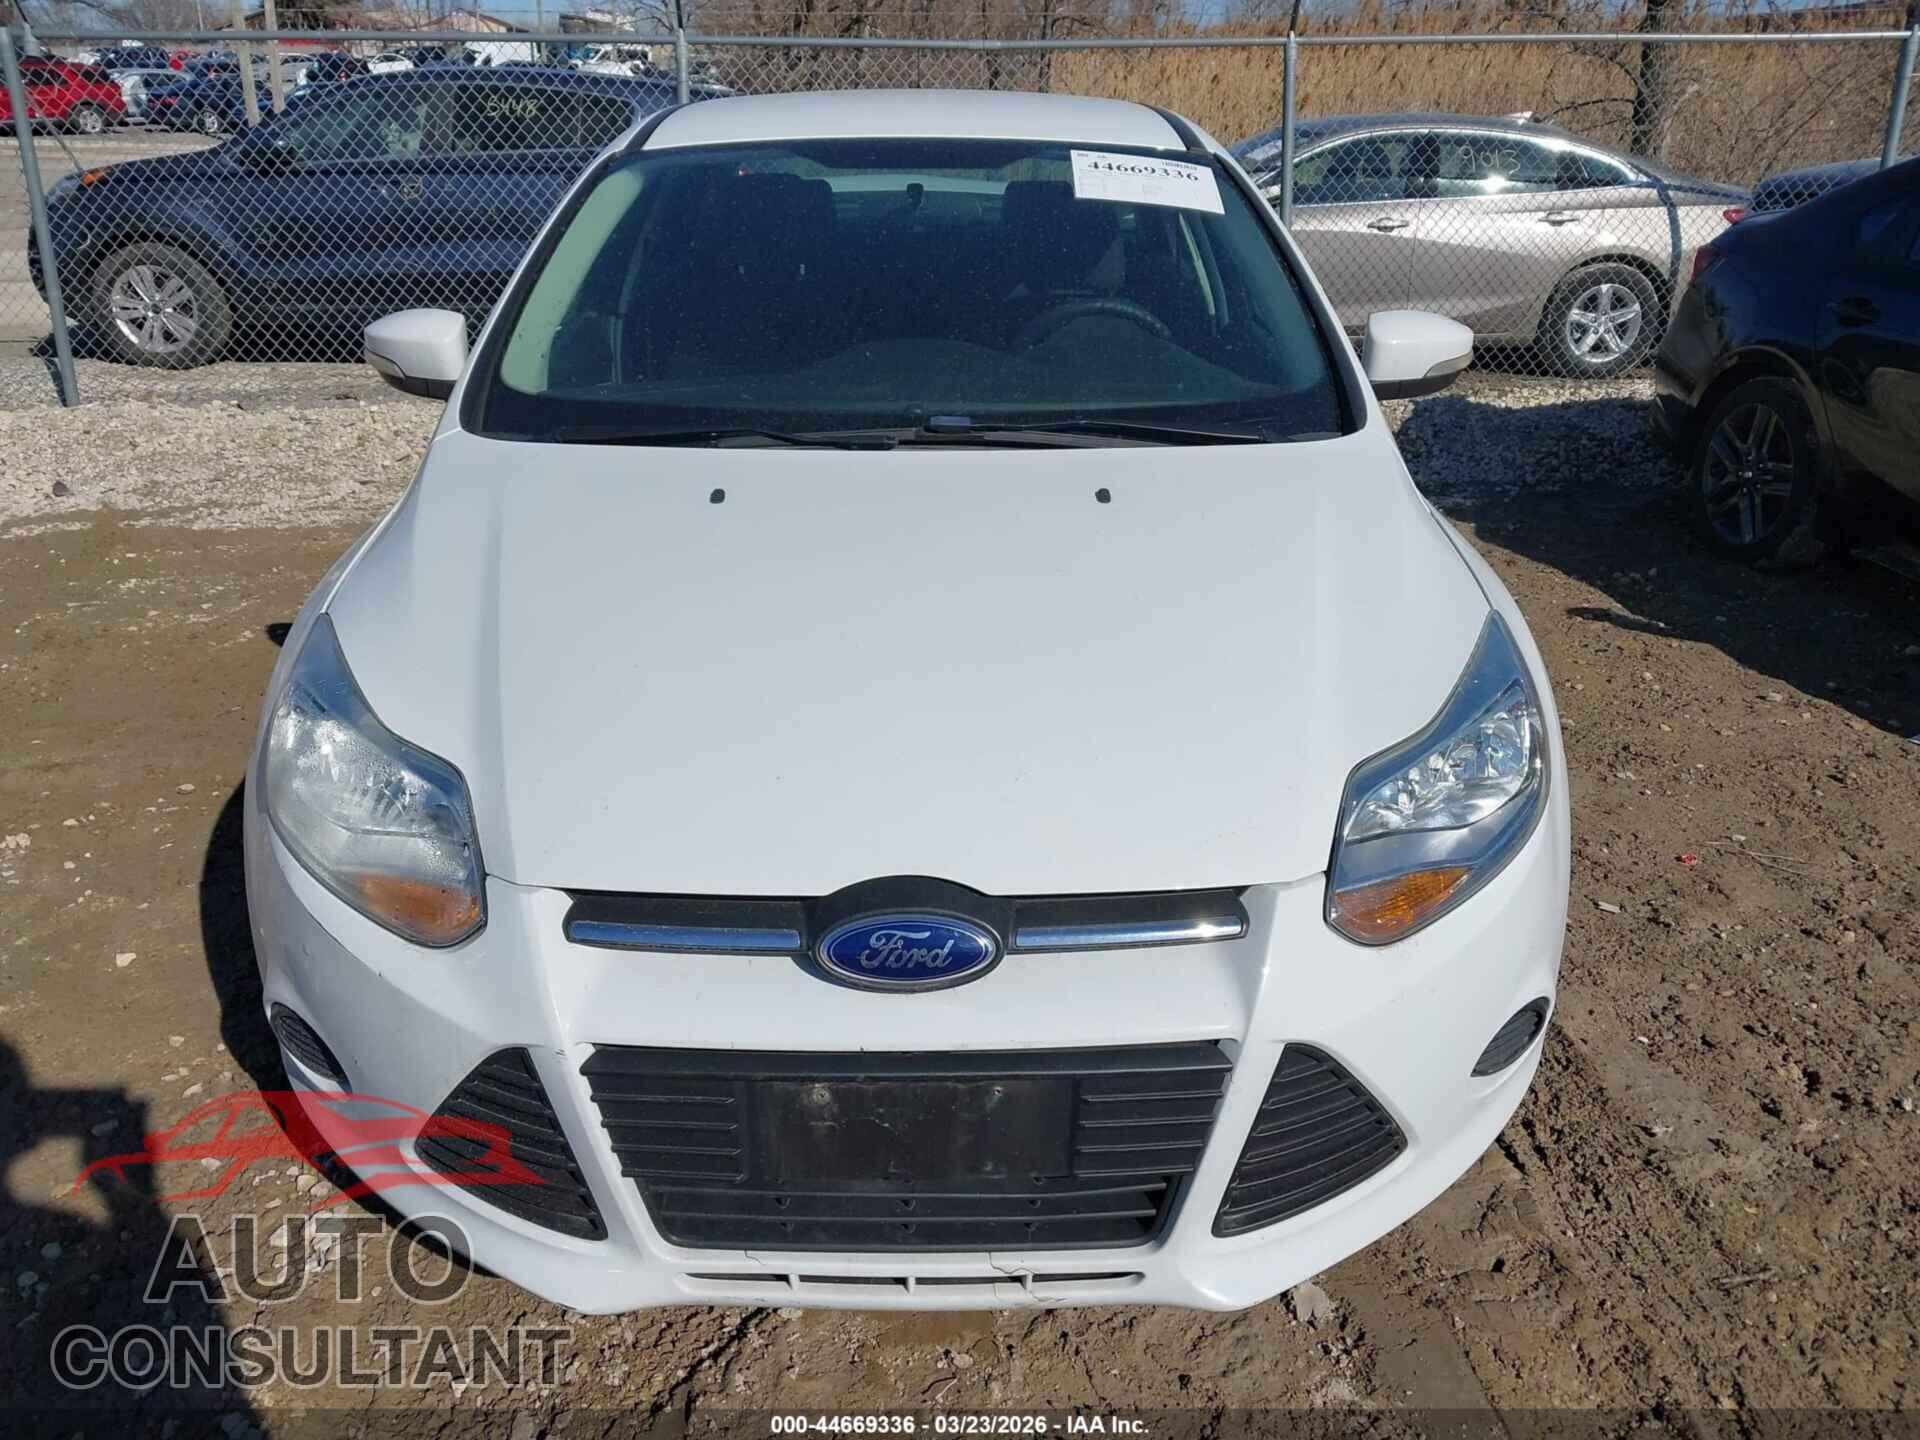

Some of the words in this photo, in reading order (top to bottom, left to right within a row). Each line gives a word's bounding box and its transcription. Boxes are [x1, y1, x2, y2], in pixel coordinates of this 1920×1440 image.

[1087, 161, 1199, 181] 44669336
[1459, 145, 1521, 176] 9013
[858, 929, 955, 970] Ford
